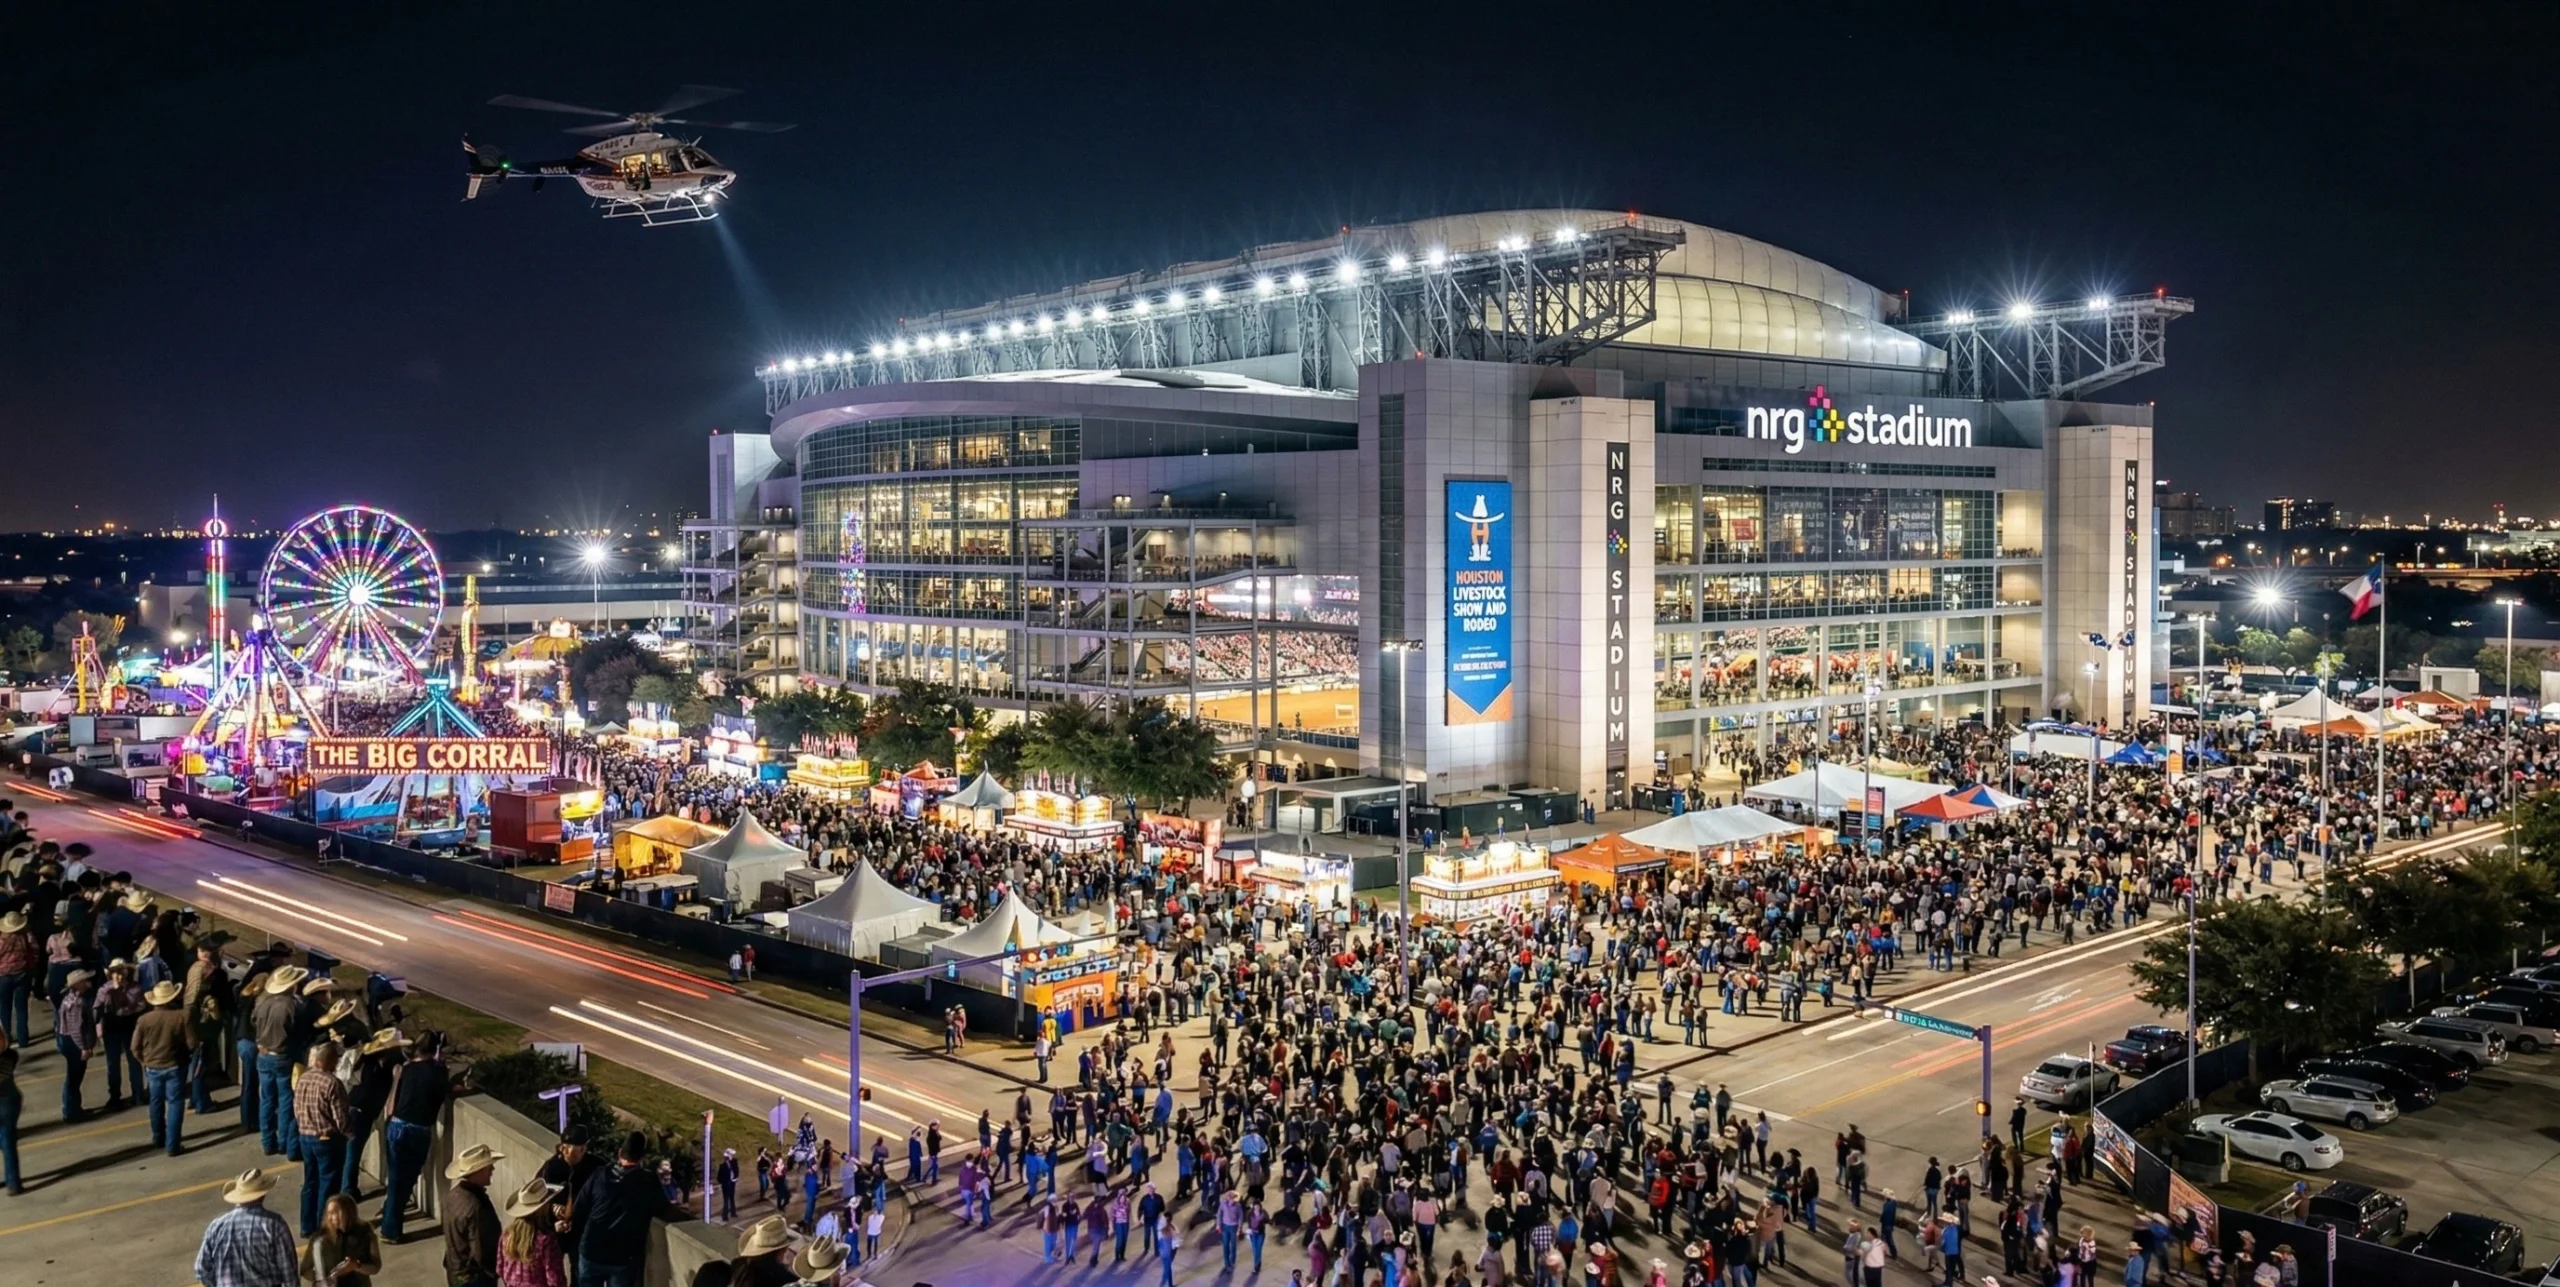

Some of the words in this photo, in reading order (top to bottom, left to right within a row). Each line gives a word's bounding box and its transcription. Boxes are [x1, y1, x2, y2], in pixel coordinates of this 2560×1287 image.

[1747, 407, 1805, 454] nrg
[1847, 404, 1972, 448] stadium
[1611, 451, 1624, 520] NRG
[2127, 467, 2136, 519] NRG
[1456, 570, 1504, 585] HOUSTON
[1453, 586, 1507, 601] LIVESTOCK
[1453, 602, 1483, 617] SHOW
[1485, 601, 1507, 616] AND
[1463, 617, 1497, 632] RODEO
[1609, 570, 1625, 742] STADIUM
[315, 746, 359, 765] THE
[367, 743, 418, 768] BIG
[427, 743, 547, 768] CORRAL
